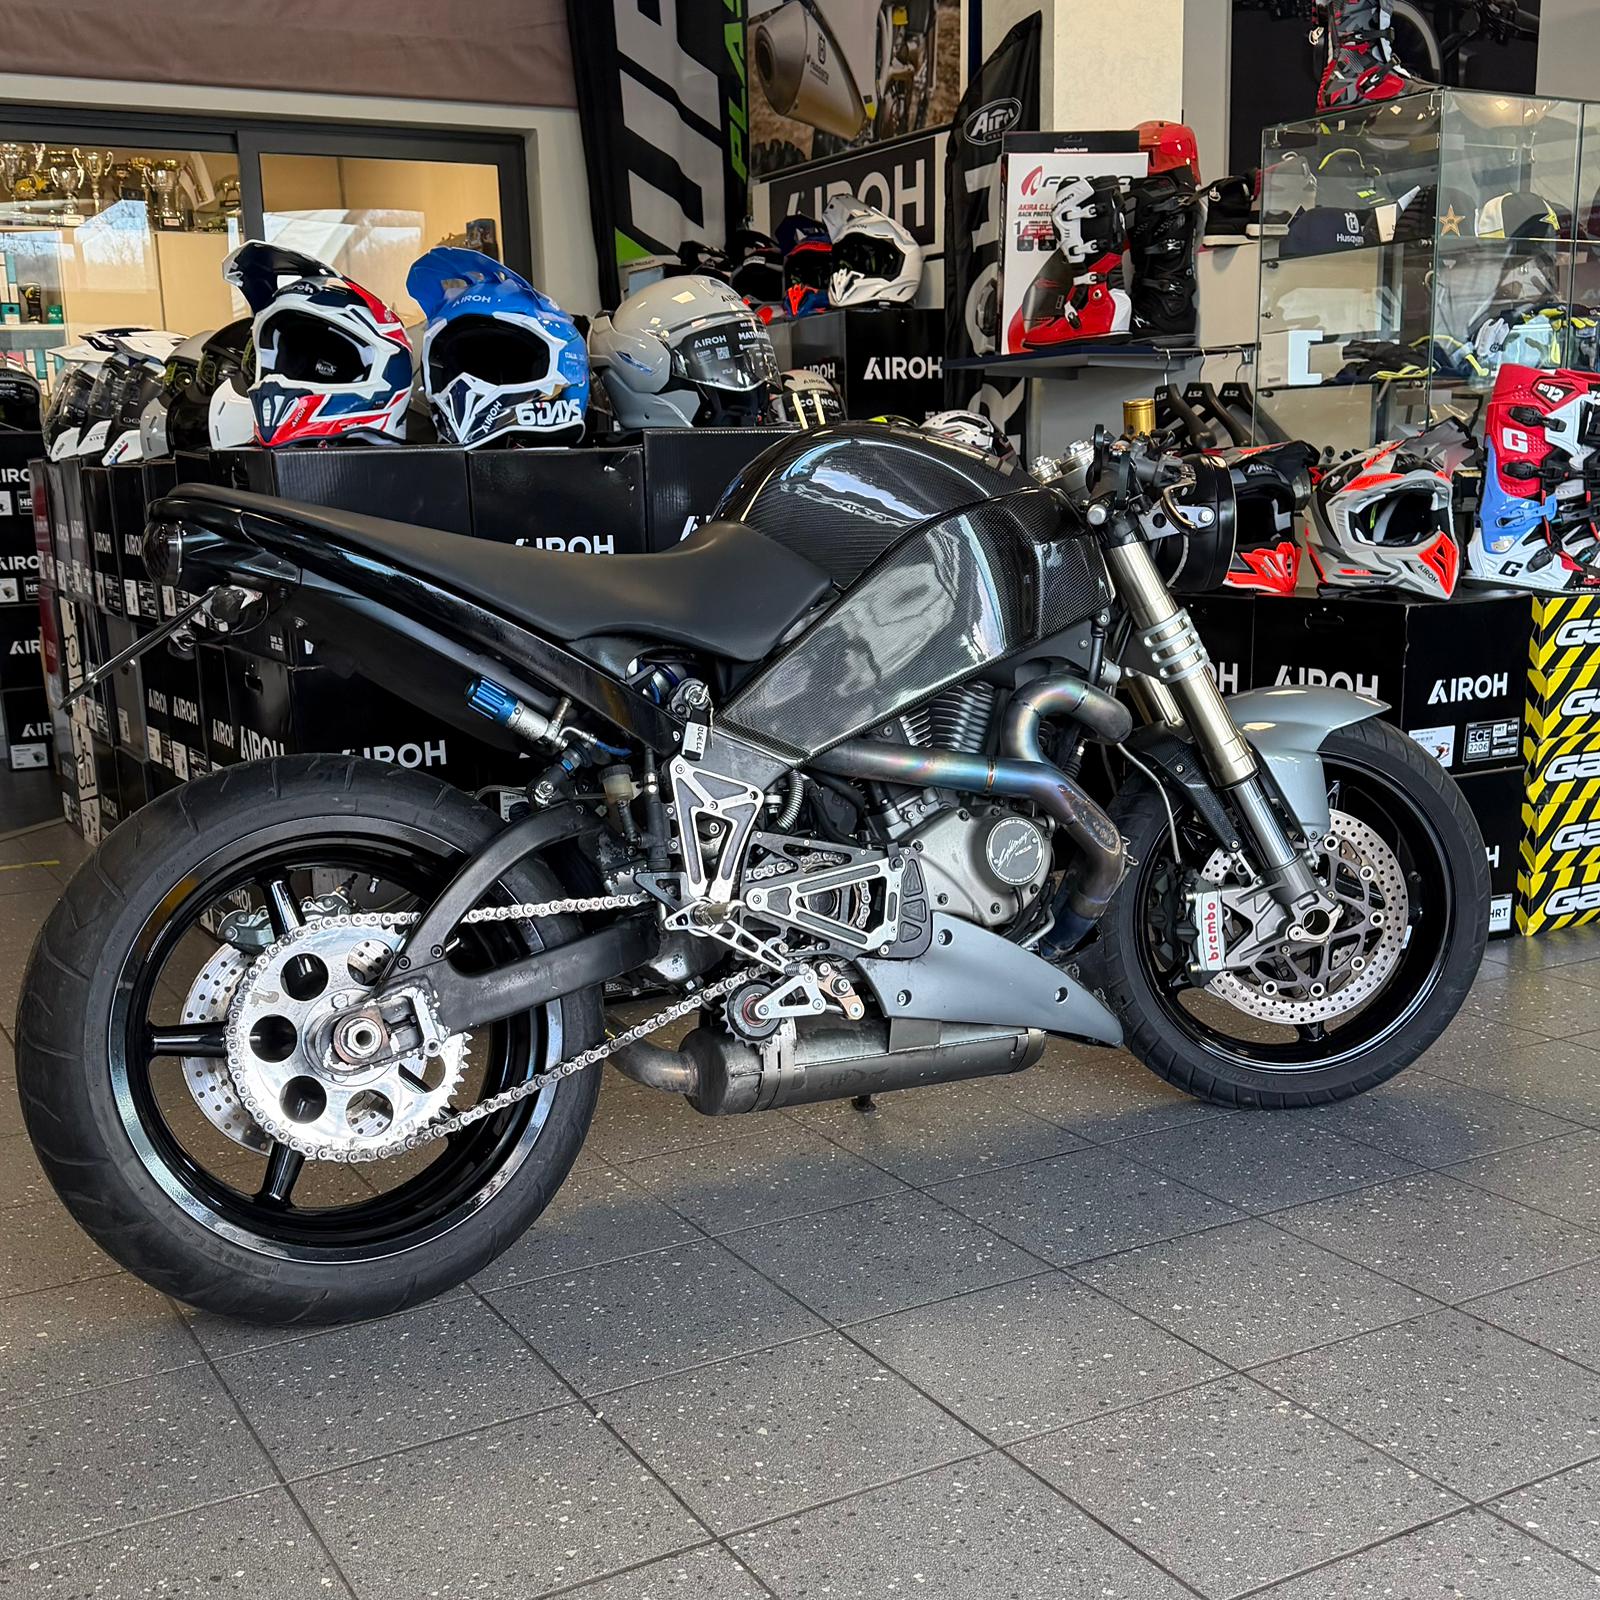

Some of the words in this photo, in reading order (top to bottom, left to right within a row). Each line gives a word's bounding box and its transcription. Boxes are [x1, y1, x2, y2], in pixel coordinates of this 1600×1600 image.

[694, 335, 727, 348] AIROH
[863, 356, 943, 380] AIROH
[1156, 392, 1167, 401] LS2
[481, 401, 503, 432] AIROH
[515, 399, 582, 425] 6DAYS
[1417, 564, 1439, 584] AIROH
[1427, 672, 1509, 705] AIROH
[173, 696, 199, 725] AIROH
[1469, 730, 1491, 742] ECE
[1470, 743, 1488, 752] 2206
